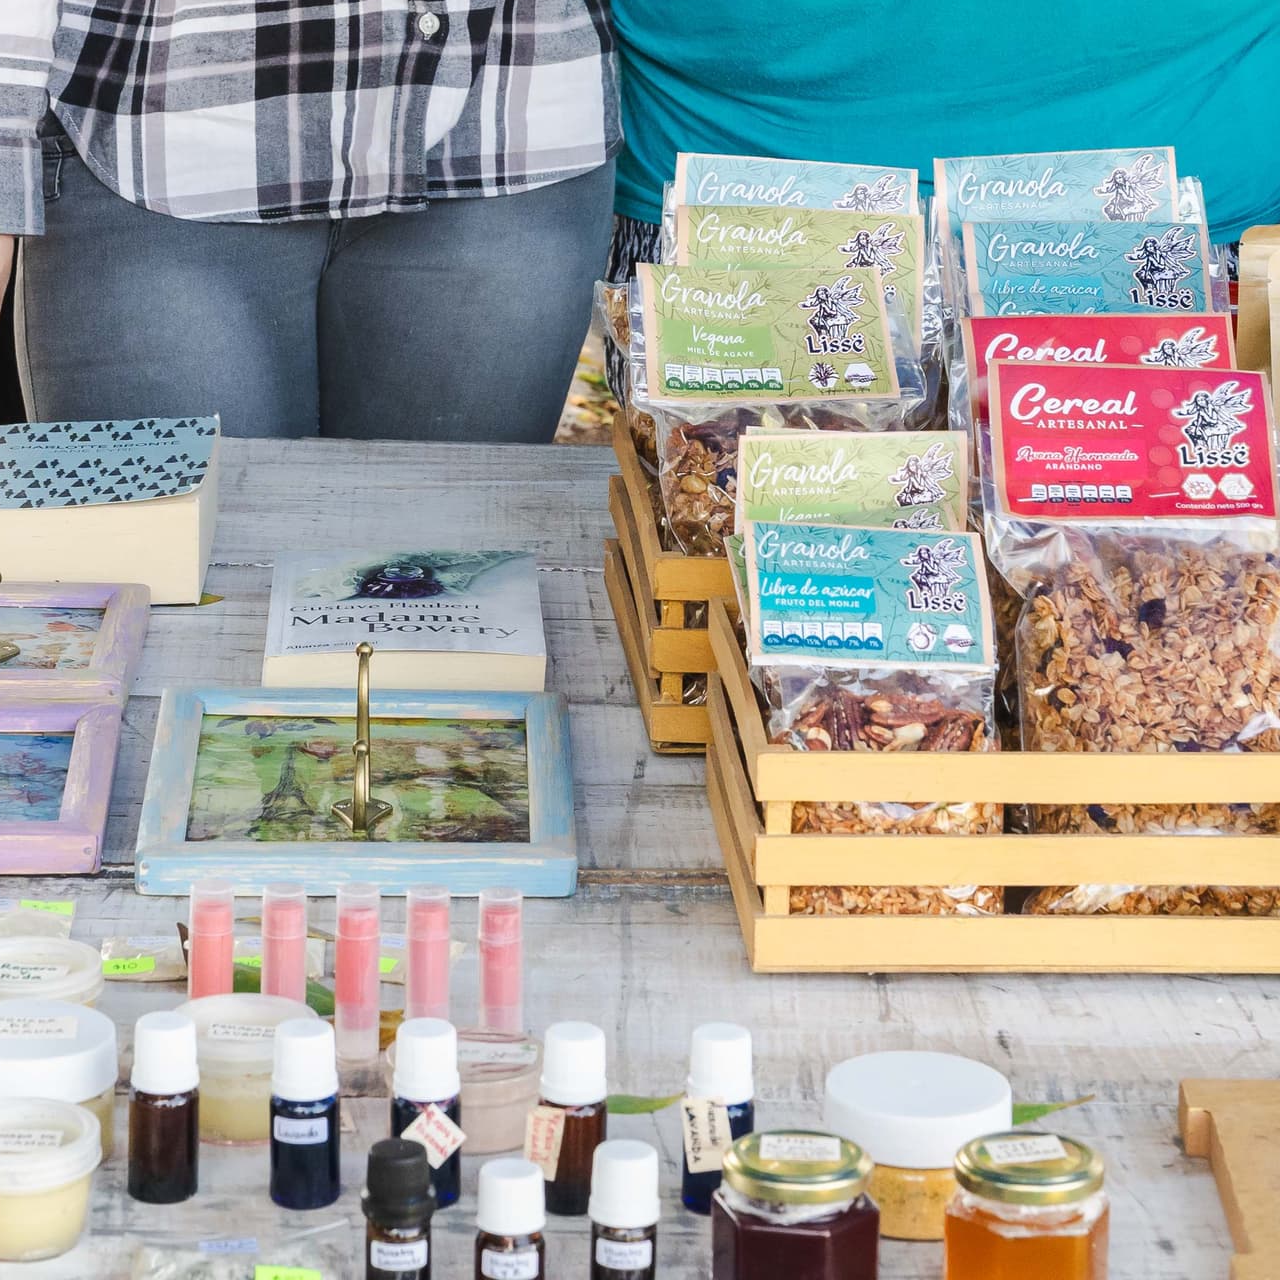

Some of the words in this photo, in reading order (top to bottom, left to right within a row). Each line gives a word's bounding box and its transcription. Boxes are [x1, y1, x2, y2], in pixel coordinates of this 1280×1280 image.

[697, 171, 808, 206] Granola
[958, 167, 1067, 206] Granola
[696, 213, 808, 247] Granola
[720, 245, 785, 256] ARTESANAL
[987, 232, 1099, 262] Granola
[661, 273, 765, 310] Granola
[1029, 278, 1048, 294] de
[683, 307, 748, 320] ARTESANAL
[692, 325, 746, 352] Vegana
[807, 334, 865, 354] Lissë
[724, 349, 755, 358] AGAVE
[984, 333, 1107, 365] Cereal
[1010, 383, 1137, 421] Cereal
[1037, 419, 1128, 430] ARTESANAL
[1016, 446, 1063, 462] Avena
[1064, 446, 1138, 463] Horneada
[1179, 445, 1246, 466] Lissë
[750, 448, 858, 488] Granola
[1045, 461, 1103, 471] ARÁNDANO
[773, 486, 840, 497] ARTESANAL
[1175, 502, 1215, 510] Contenido
[758, 530, 870, 562] Granola
[782, 559, 850, 570] ARTESANAL
[761, 577, 797, 597] Libre
[800, 579, 819, 596] de
[821, 581, 874, 600] azúcar
[289, 602, 380, 612] Gustave
[389, 601, 481, 610] Flaubert
[775, 598, 805, 607] FRUTO
[808, 599, 826, 608] DEL
[907, 593, 966, 612] Lissë
[291, 611, 481, 627] Madame
[368, 622, 519, 639] Bovary
